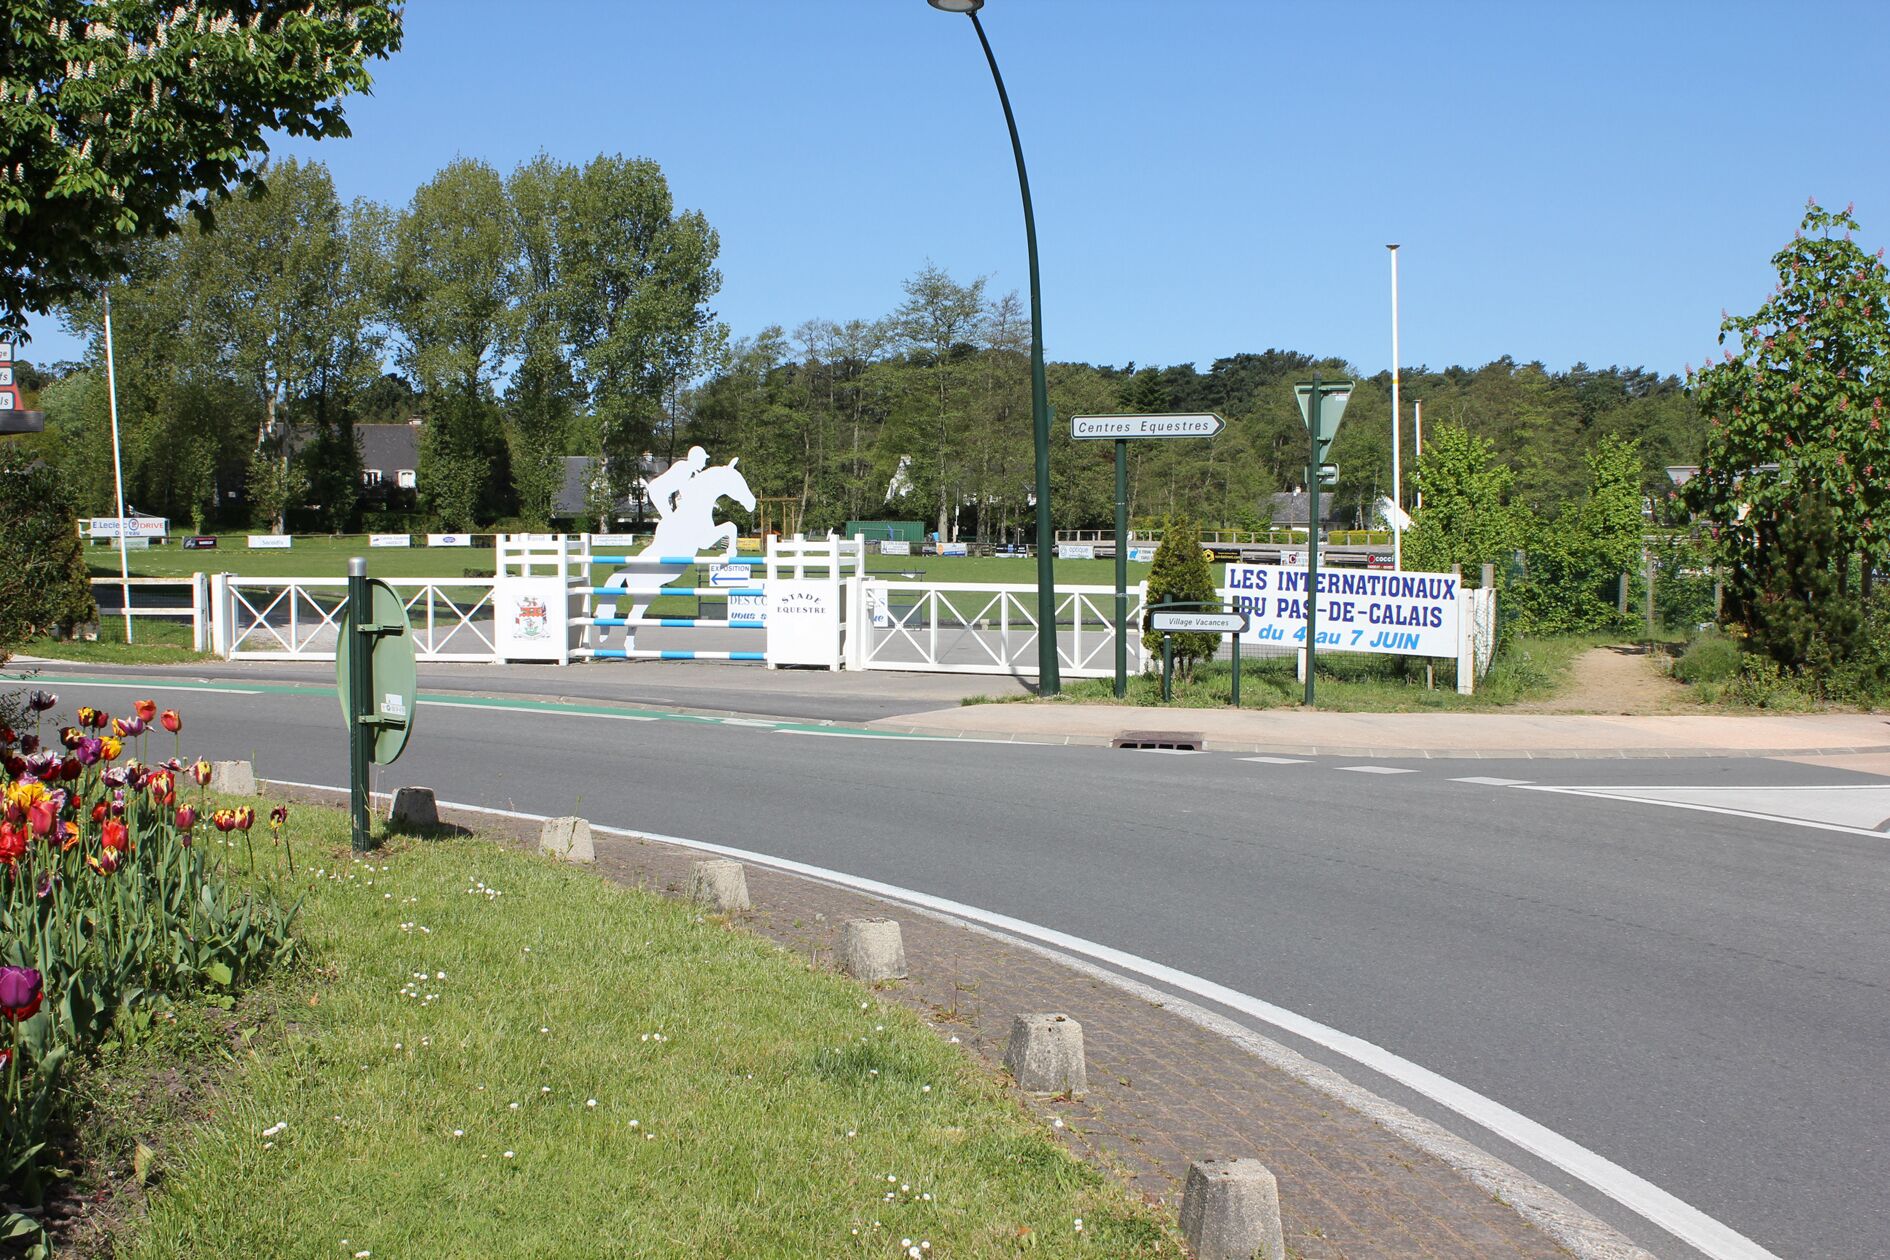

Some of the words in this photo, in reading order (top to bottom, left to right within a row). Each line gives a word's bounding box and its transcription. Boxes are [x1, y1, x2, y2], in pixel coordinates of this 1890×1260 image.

[1078, 422, 1130, 433] Centres
[1140, 420, 1209, 434] Equestres
[1229, 568, 1268, 590] LES
[1277, 571, 1456, 601] INTERNATIONAUX
[781, 593, 822, 604] STADE
[777, 606, 826, 614] EQUESTRE
[1240, 596, 1267, 618] DU
[1276, 598, 1443, 628] PAS-DE-CALAIS
[1169, 618, 1193, 627] Village
[1258, 624, 1284, 641] du
[1293, 626, 1307, 641] 4
[1315, 631, 1341, 645] au
[1350, 629, 1364, 646] 7
[1369, 631, 1420, 650] JUIN
